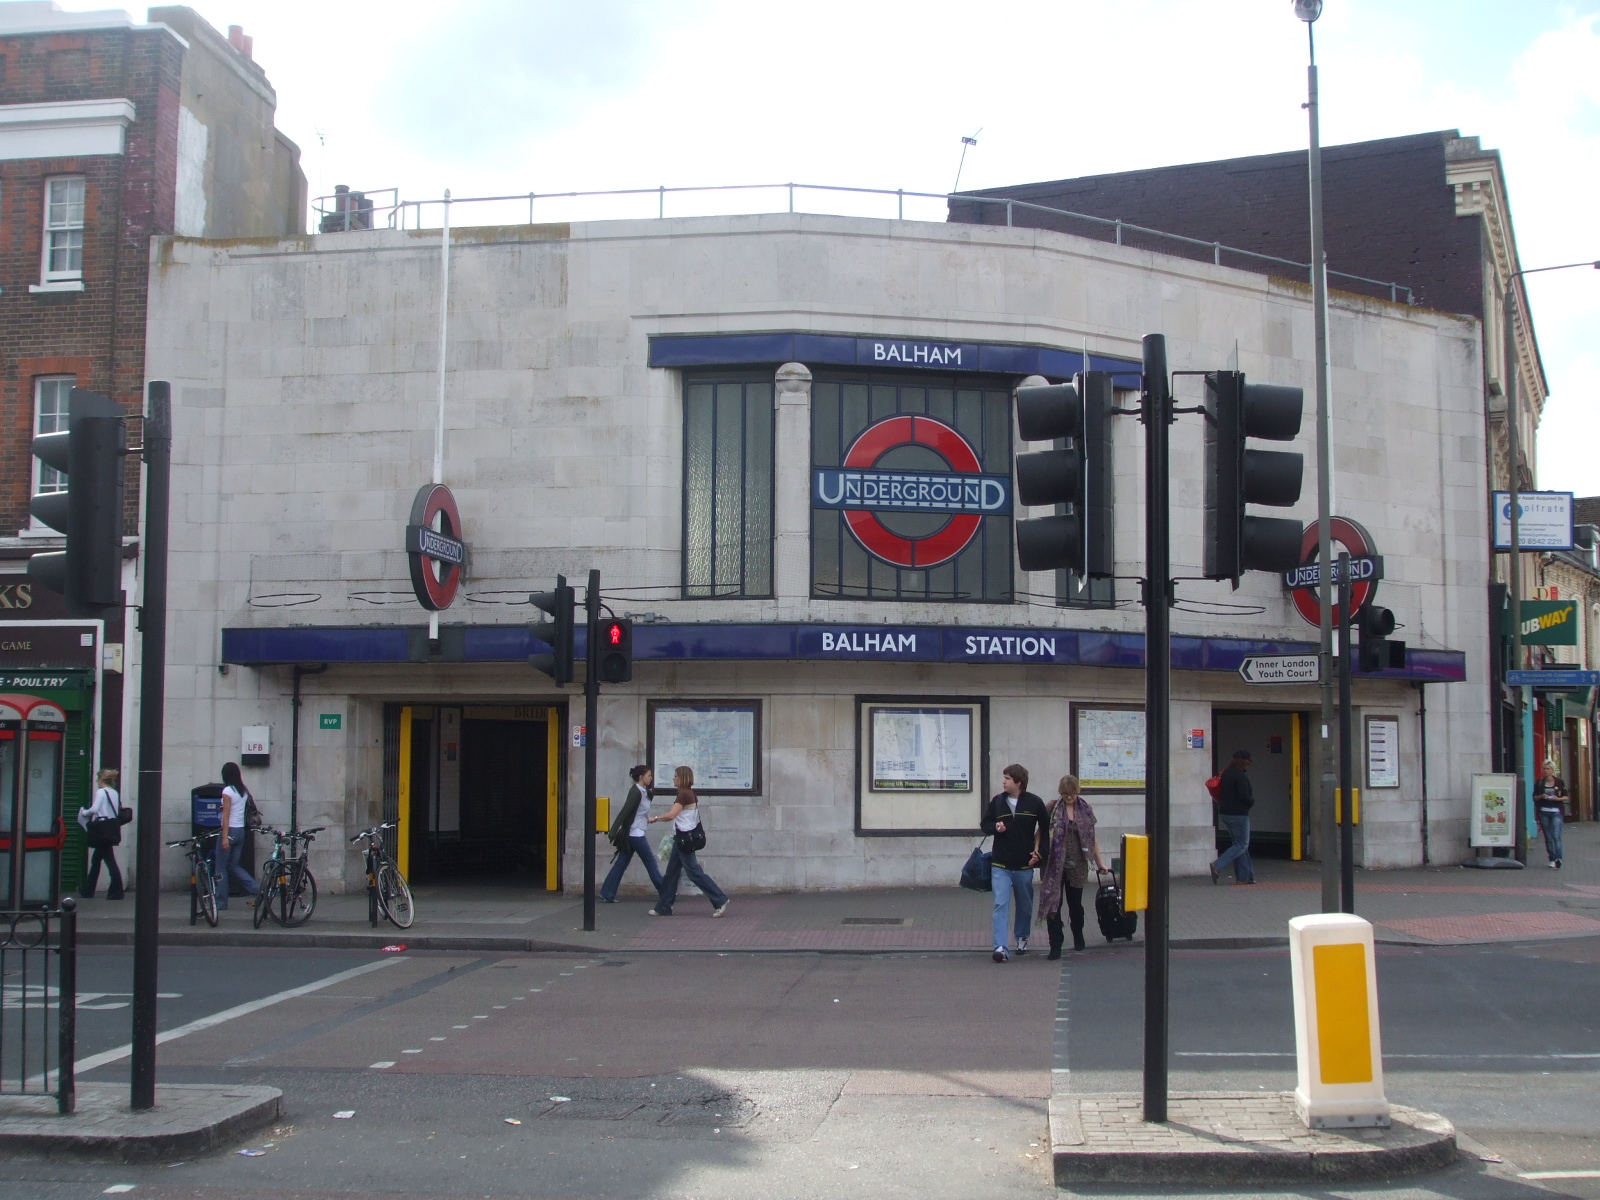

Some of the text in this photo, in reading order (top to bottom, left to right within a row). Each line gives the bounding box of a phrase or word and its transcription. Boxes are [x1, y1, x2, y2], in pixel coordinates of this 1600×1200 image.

[874, 343, 962, 365] BALHAM
[818, 472, 1005, 510] UNDERGROUND
[419, 529, 463, 563] UNDERGROUND
[1286, 559, 1374, 587] UNDERND
[1521, 606, 1574, 636] UBWAY
[1, 641, 32, 651] GAME
[822, 632, 1056, 656] BALHAM STATION
[1255, 659, 1316, 669] Inner London
[1258, 669, 1313, 678] Youth Court
[12, 677, 68, 687] POULTRY
[247, 743, 263, 752] LFB
